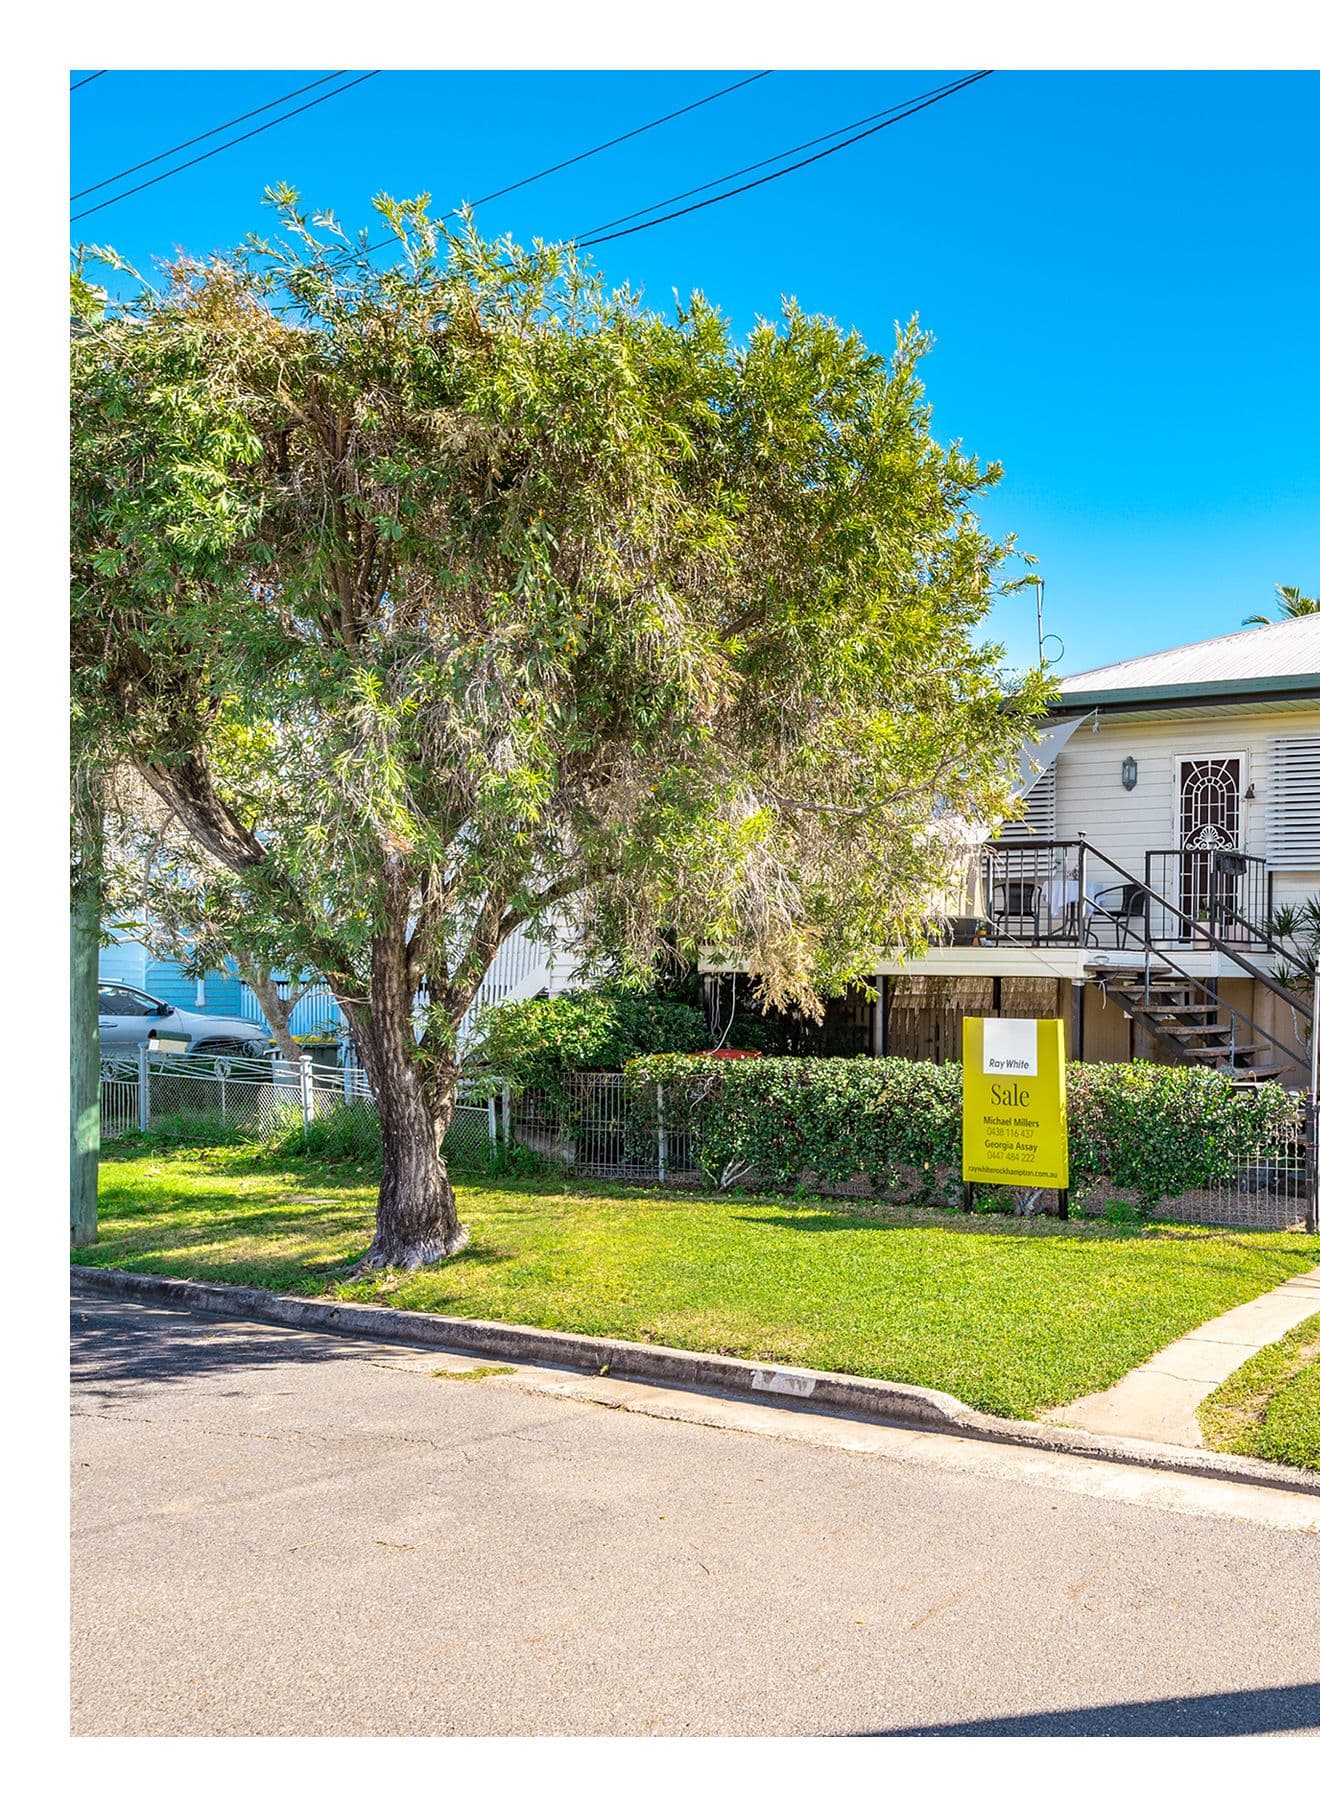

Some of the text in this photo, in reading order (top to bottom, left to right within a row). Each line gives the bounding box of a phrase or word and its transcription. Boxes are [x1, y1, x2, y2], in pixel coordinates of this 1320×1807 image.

[989, 1058, 1029, 1070] Ray White
[991, 1083, 1030, 1107] Sale
[983, 1116, 1040, 1128] Michael Millers
[986, 1127, 1004, 1136] 0438
[1020, 1129, 1034, 1138] 437
[984, 1139, 1038, 1153] Georgia Assay
[986, 1150, 1003, 1160] 0447
[1020, 1153, 1036, 1162] 222
[968, 1165, 1058, 1178] raywhiterockhampton.com.au
